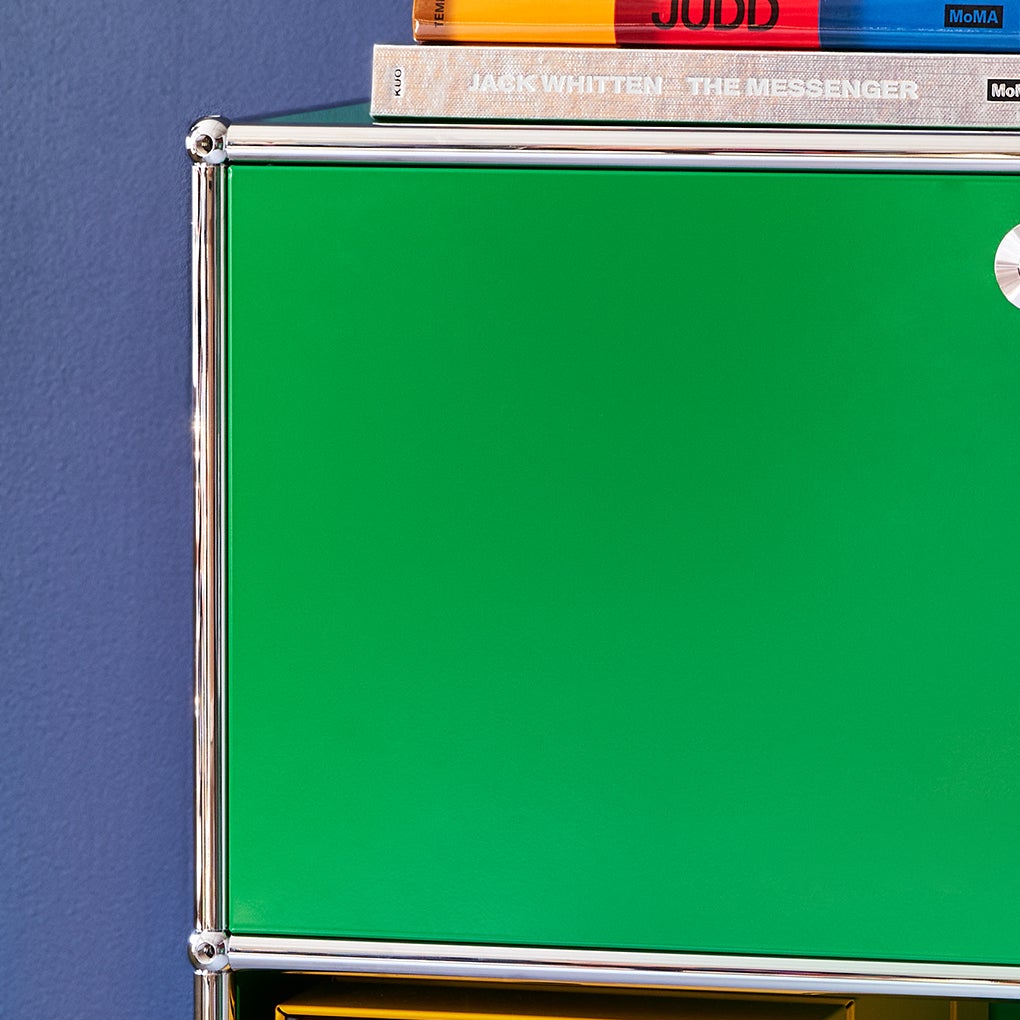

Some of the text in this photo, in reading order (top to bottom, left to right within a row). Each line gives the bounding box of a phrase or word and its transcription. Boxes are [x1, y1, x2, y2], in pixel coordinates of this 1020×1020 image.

[651, 0, 780, 32] JUDD
[949, 9, 998, 24] MoMA
[394, 68, 402, 97] KUO
[467, 73, 919, 100] JACK WHITTEN THE MESSENGER
